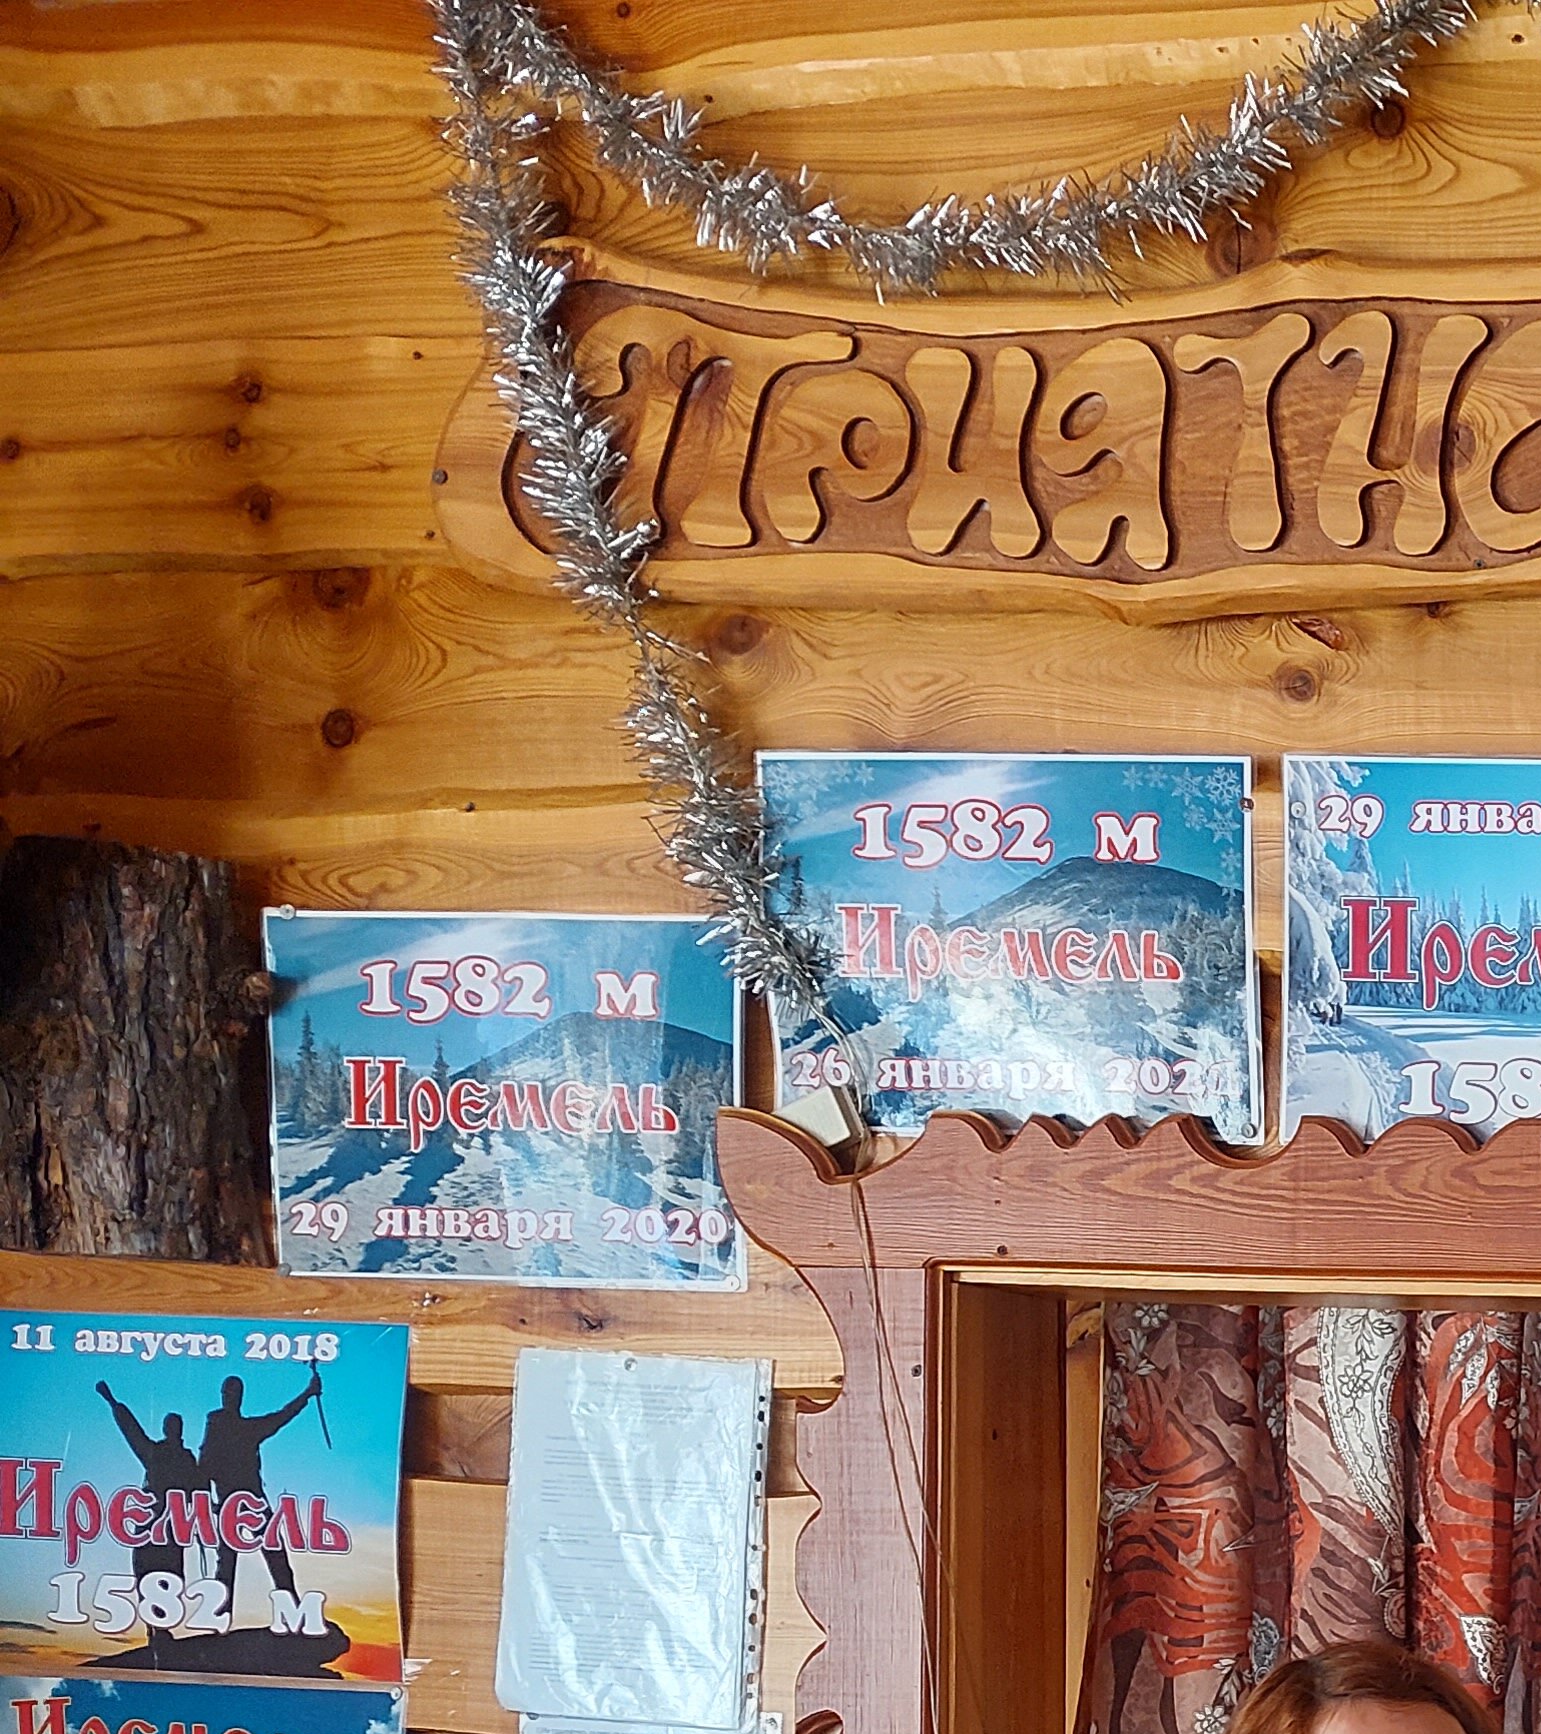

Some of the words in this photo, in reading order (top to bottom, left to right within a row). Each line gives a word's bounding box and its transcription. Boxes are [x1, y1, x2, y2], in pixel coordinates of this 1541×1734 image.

[853, 799, 1056, 871] 1582
[1094, 812, 1161, 865] м
[1317, 794, 1385, 838] 29
[835, 902, 1184, 1003] Иремель
[359, 955, 552, 1024] 1582
[595, 970, 660, 1019] м
[344, 1056, 680, 1153] Иремель
[790, 1047, 852, 1091] 26
[875, 1057, 1079, 1100] января
[290, 1201, 350, 1243] 29
[374, 1205, 574, 1249] января
[601, 1206, 730, 1247] 2020
[11, 1324, 55, 1350] 11
[74, 1329, 227, 1361] августа
[244, 1332, 340, 1362] 2018
[0, 1457, 353, 1567] Иремель
[47, 1571, 232, 1636] 1582
[268, 1588, 329, 1638] м
